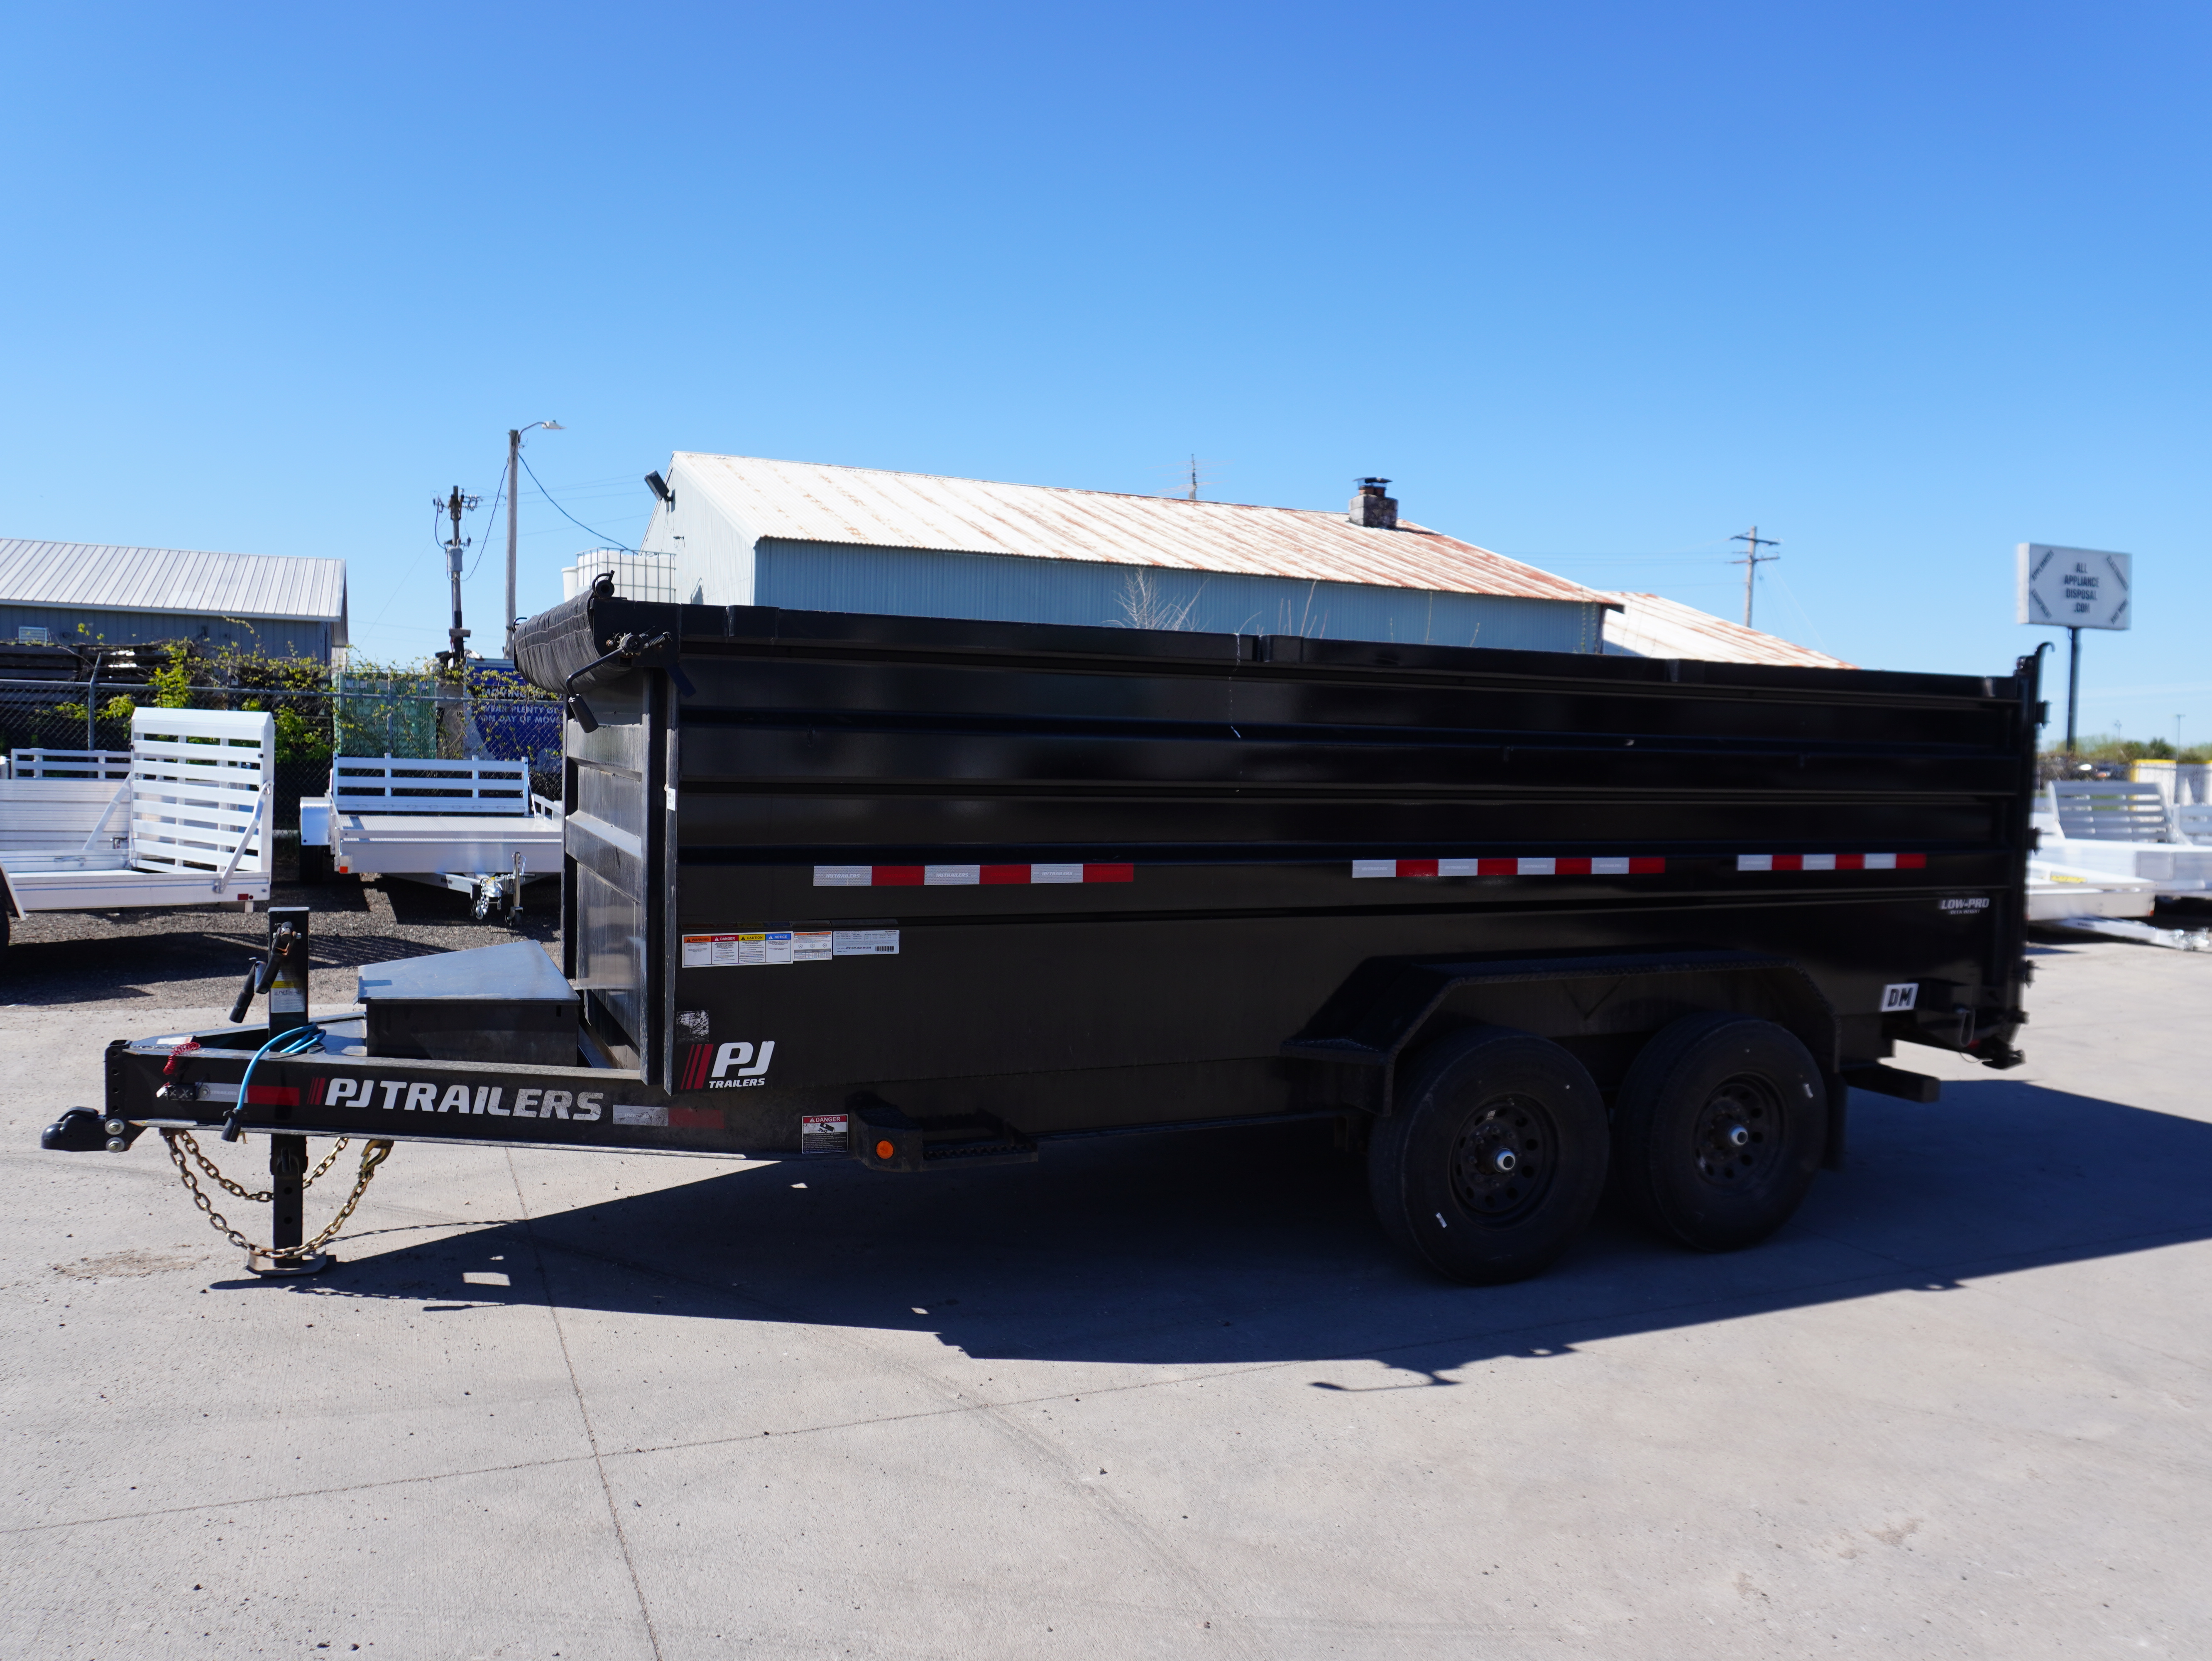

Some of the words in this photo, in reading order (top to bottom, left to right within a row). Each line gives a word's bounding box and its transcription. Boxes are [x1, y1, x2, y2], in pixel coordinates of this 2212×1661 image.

[2076, 563, 2087, 573] ALL
[2064, 574, 2099, 587] APPLIANCE
[2066, 588, 2097, 600] DISPOSAL
[2074, 603, 2090, 613] .COM
[482, 688, 526, 698] MOVING
[499, 714, 517, 723] DAY
[1941, 898, 1990, 909] LOW-PRO
[1887, 987, 1913, 1007] DM
[711, 1041, 775, 1077] PJ
[709, 1078, 765, 1088] TRAILERS
[325, 1078, 375, 1107] PJ
[379, 1080, 604, 1121] TRAILERS
